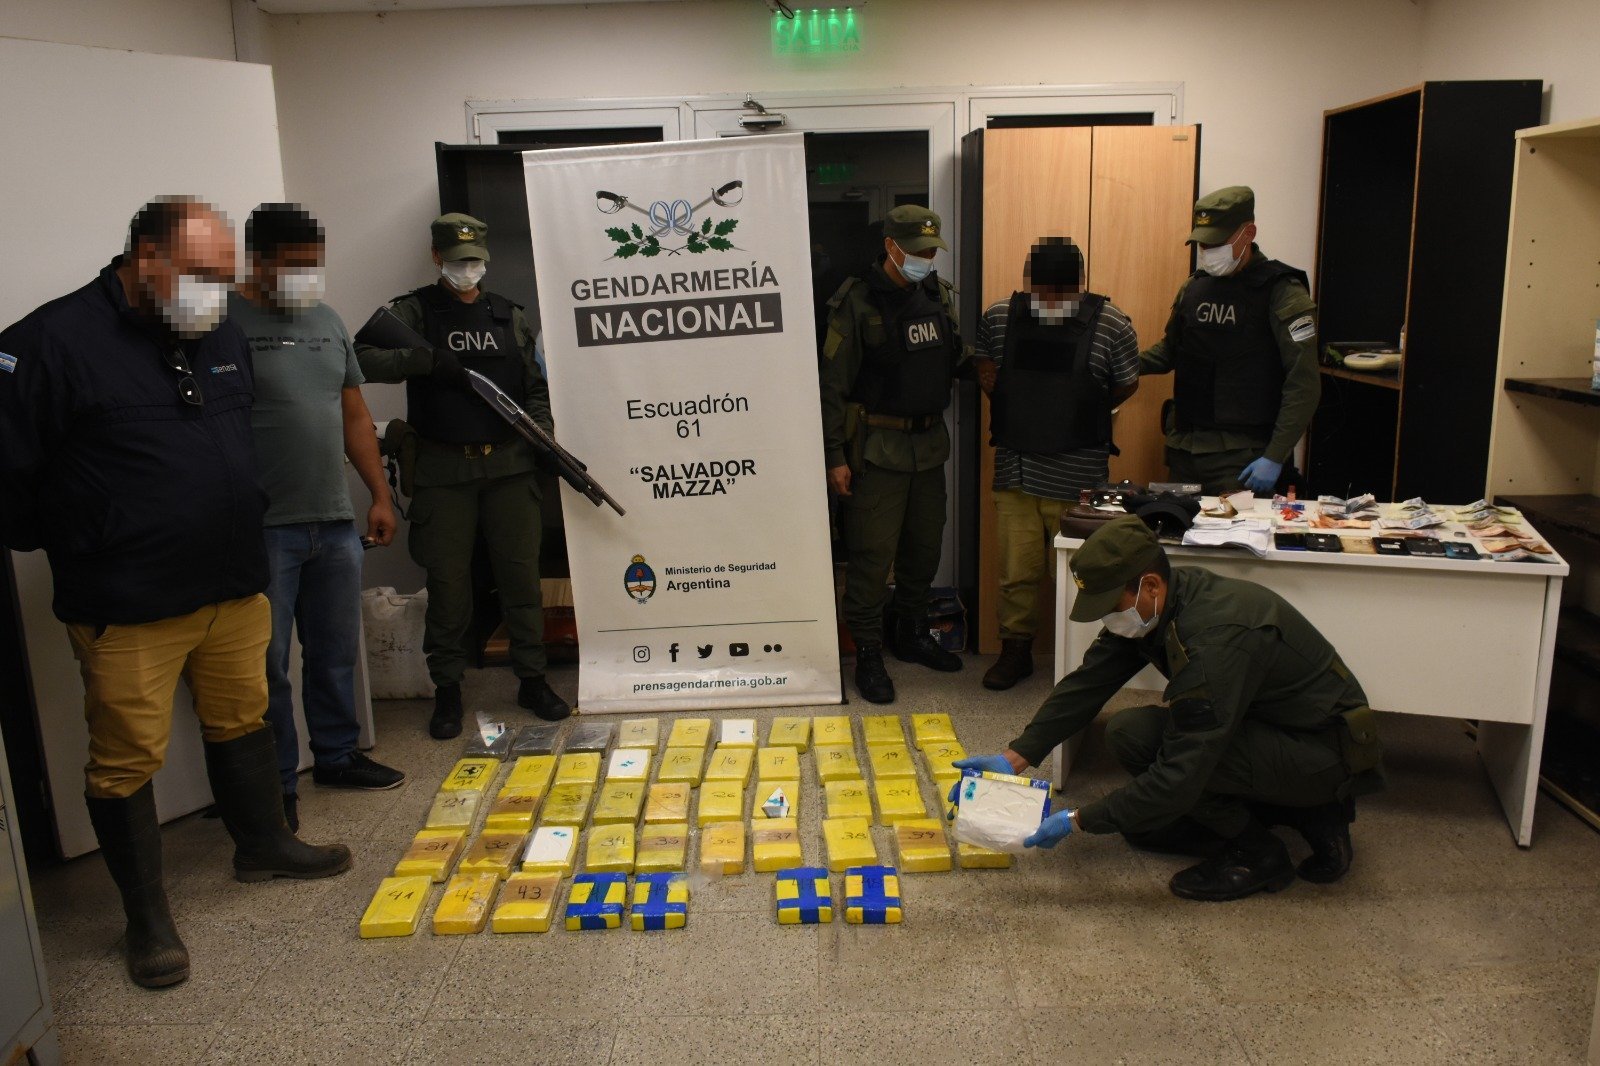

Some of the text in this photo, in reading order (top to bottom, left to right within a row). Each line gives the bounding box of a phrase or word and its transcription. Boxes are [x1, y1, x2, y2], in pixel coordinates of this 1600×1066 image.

[776, 18, 859, 45] SALIDA
[571, 261, 779, 301] GENDARMERÍA
[1196, 302, 1236, 325] GNA
[590, 301, 774, 340] NACIONAL
[908, 322, 938, 344] GNA
[448, 331, 499, 351] GNA
[626, 393, 749, 420] Escuadrón
[677, 419, 701, 438] 61
[630, 459, 757, 482] “SALVADOR
[652, 478, 736, 499] MAZZA”
[665, 562, 776, 575] Ministerio de Seguridad
[666, 578, 731, 593] Argentina
[633, 675, 788, 693] prensagendarmeria.gob.ar
[824, 723, 836, 733] 8
[922, 718, 940, 726] 10
[632, 724, 647, 734] 4
[672, 754, 692, 765] 15
[882, 751, 899, 760] 19
[938, 748, 960, 758] 20
[720, 755, 737, 767] 16
[774, 756, 785, 765] 17
[610, 790, 634, 800] 24
[601, 837, 626, 847] 34
[770, 831, 792, 840] 37
[908, 831, 935, 840] 39
[485, 840, 510, 850] 32
[518, 885, 541, 899] 43
